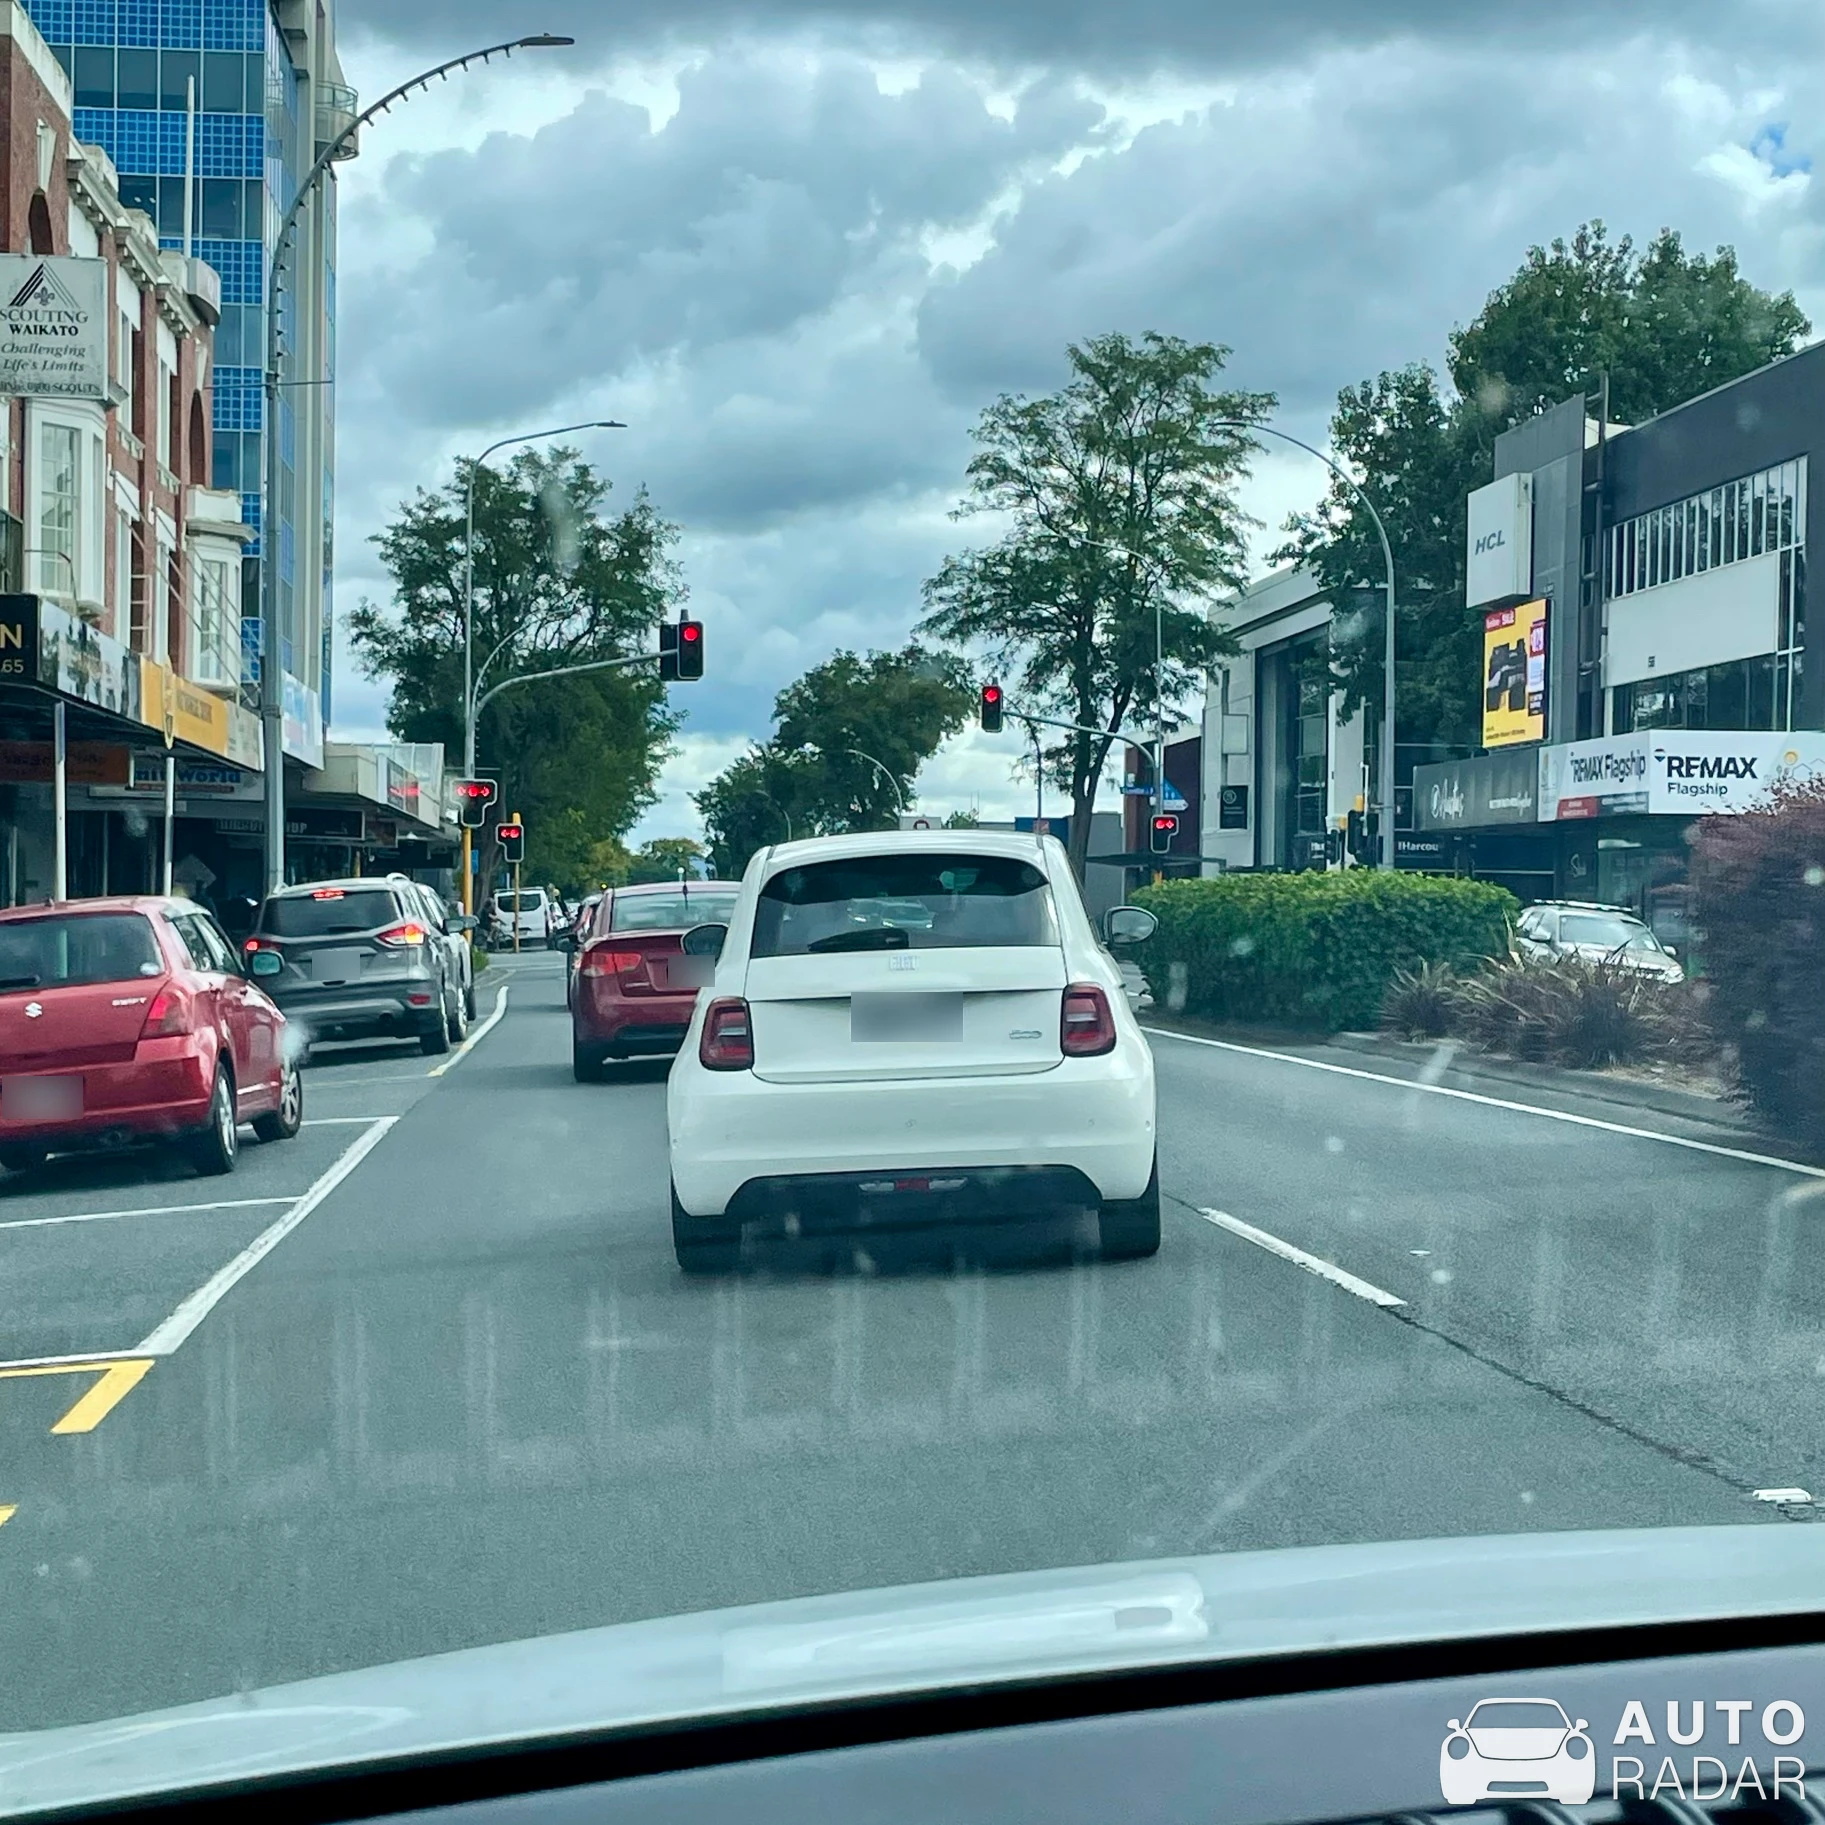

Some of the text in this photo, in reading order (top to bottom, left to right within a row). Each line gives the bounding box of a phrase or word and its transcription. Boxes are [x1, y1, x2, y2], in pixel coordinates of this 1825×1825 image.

[0, 309, 88, 323] SCOUTING
[9, 324, 78, 336] WAIKATO
[1, 343, 86, 358] Challenging
[3, 359, 84, 373] Life's Limits
[1475, 530, 1505, 555] HCL
[1573, 750, 1646, 782] REMAX Flagship
[1667, 757, 1757, 779] REMAX
[1667, 783, 1728, 796] Flagship
